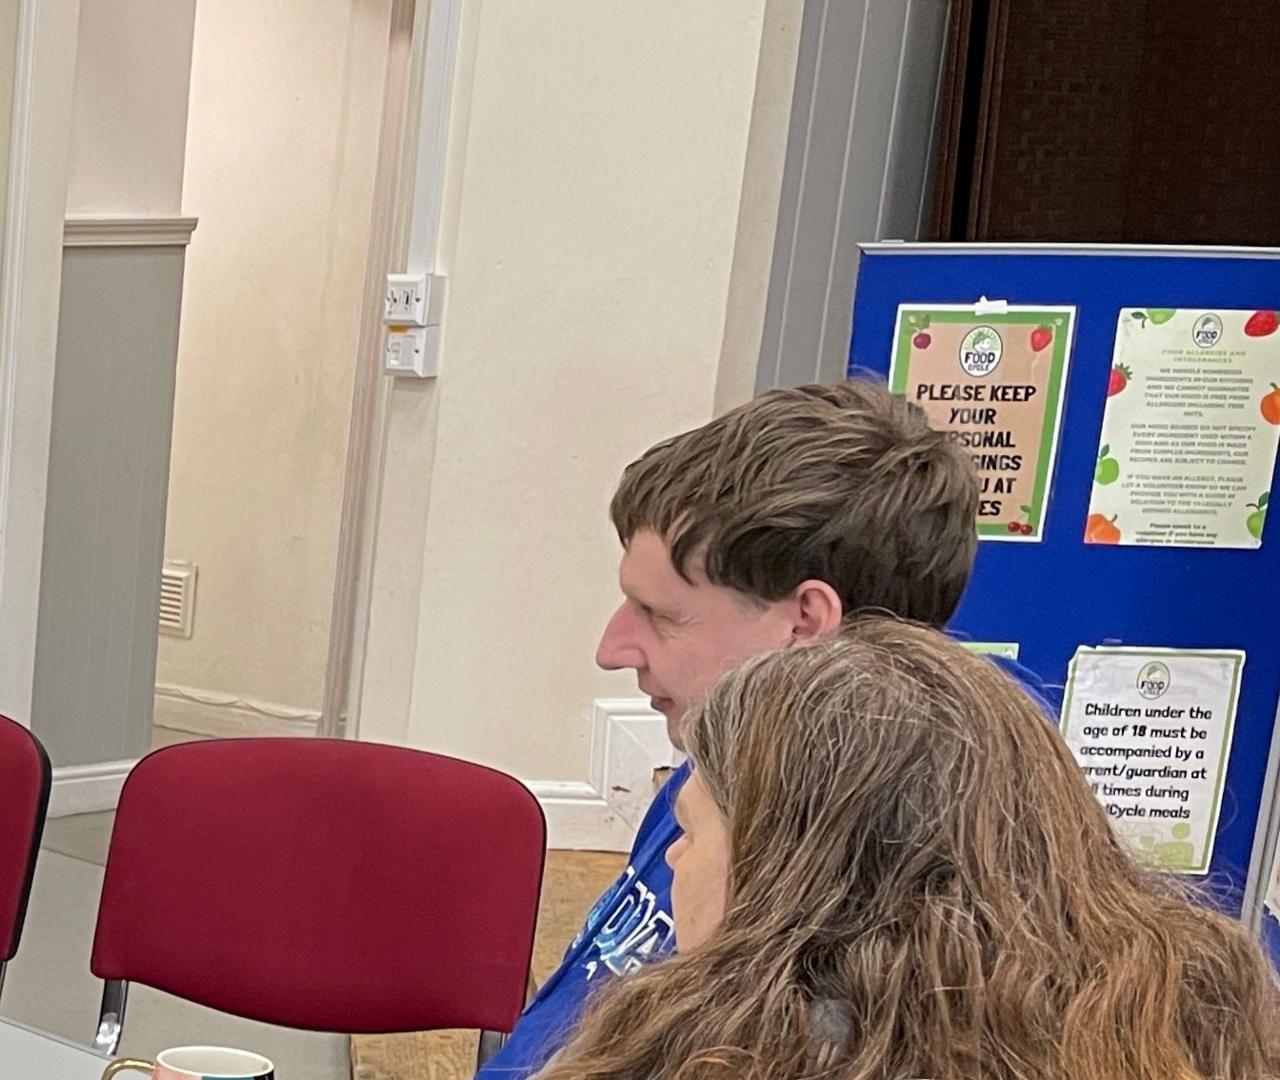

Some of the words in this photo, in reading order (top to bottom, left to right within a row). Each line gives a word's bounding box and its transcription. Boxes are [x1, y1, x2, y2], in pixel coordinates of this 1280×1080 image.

[964, 352, 996, 364] FOOD
[917, 384, 986, 401] PLEASE
[990, 385, 1037, 402] KEEP
[949, 408, 997, 425] YOUR
[994, 478, 1017, 494] AT
[1085, 703, 1141, 718] Children
[1145, 706, 1185, 719] under
[1189, 707, 1213, 720] the
[1083, 726, 1109, 740] age
[1112, 725, 1129, 737] of
[1132, 725, 1147, 737] 18
[1150, 727, 1187, 739] must
[1190, 727, 1207, 740] be
[1080, 744, 1173, 760] accompanied
[1175, 746, 1192, 762] by
[1195, 750, 1205, 760] a
[1082, 764, 1187, 780] arent/guardian
[1191, 767, 1207, 780] at
[1102, 783, 1142, 796] times
[1145, 785, 1189, 801] during
[1149, 806, 1191, 819] meals
